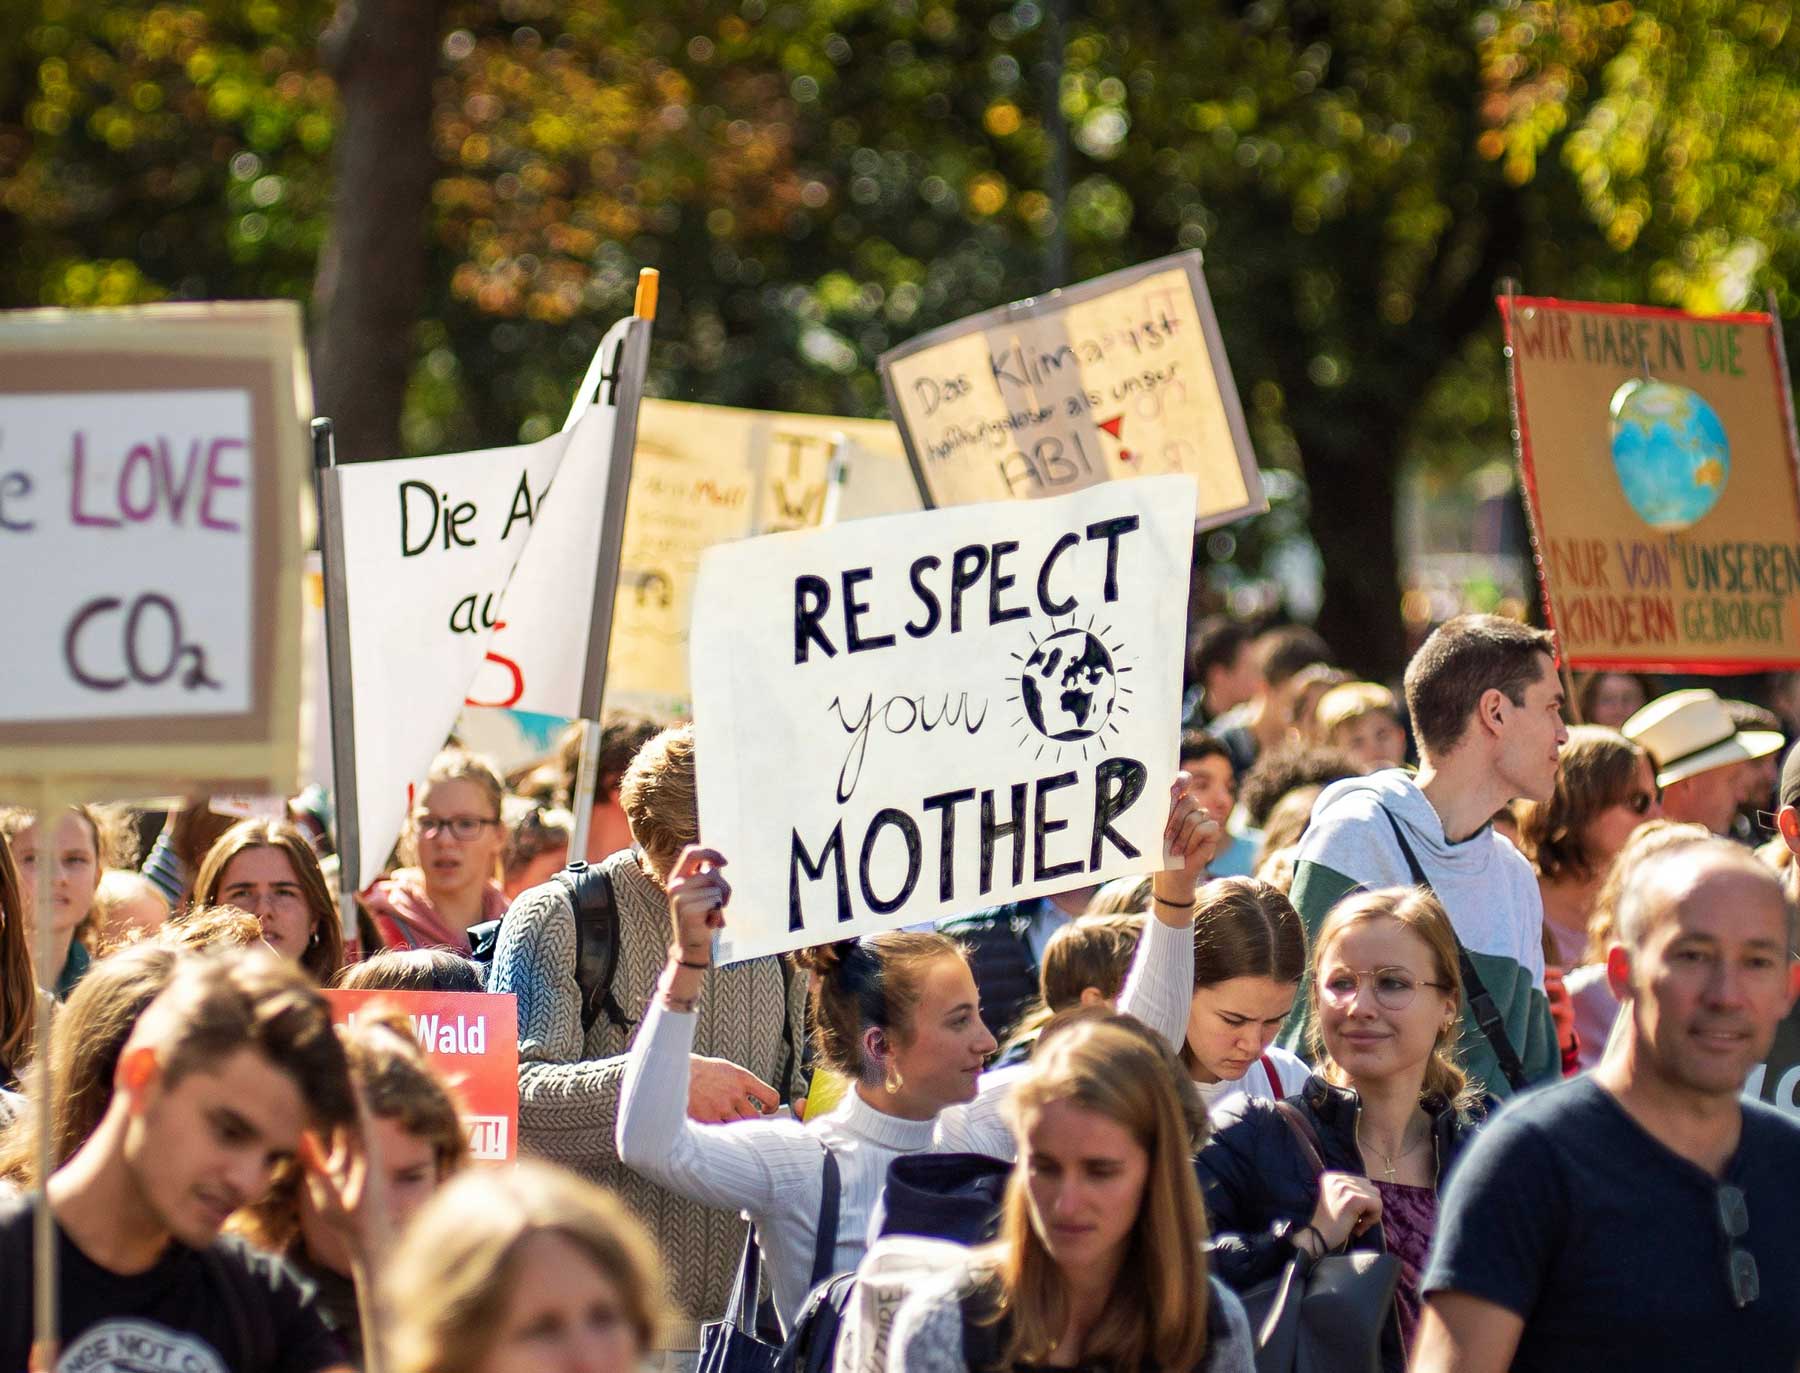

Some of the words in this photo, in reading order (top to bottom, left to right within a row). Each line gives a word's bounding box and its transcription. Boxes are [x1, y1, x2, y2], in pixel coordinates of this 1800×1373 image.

[988, 338, 1102, 394] Klima
[1126, 315, 1181, 354] ist
[1110, 361, 1181, 401] unser
[1514, 313, 1577, 362] WIR
[1582, 318, 1686, 371] HABEN
[1691, 323, 1745, 377] DIE
[70, 430, 247, 533] LOVE
[400, 480, 477, 558] Die
[794, 514, 1140, 666] RESPECT
[1548, 536, 1609, 589] NUR
[1615, 539, 1673, 590] VON
[1682, 541, 1800, 594] UNSEREN
[1556, 593, 1680, 646] KINDERN
[1682, 598, 1787, 645] GEBORGT
[827, 690, 988, 805] your
[788, 756, 1149, 934] MOTHER
[409, 1014, 487, 1055] Wald
